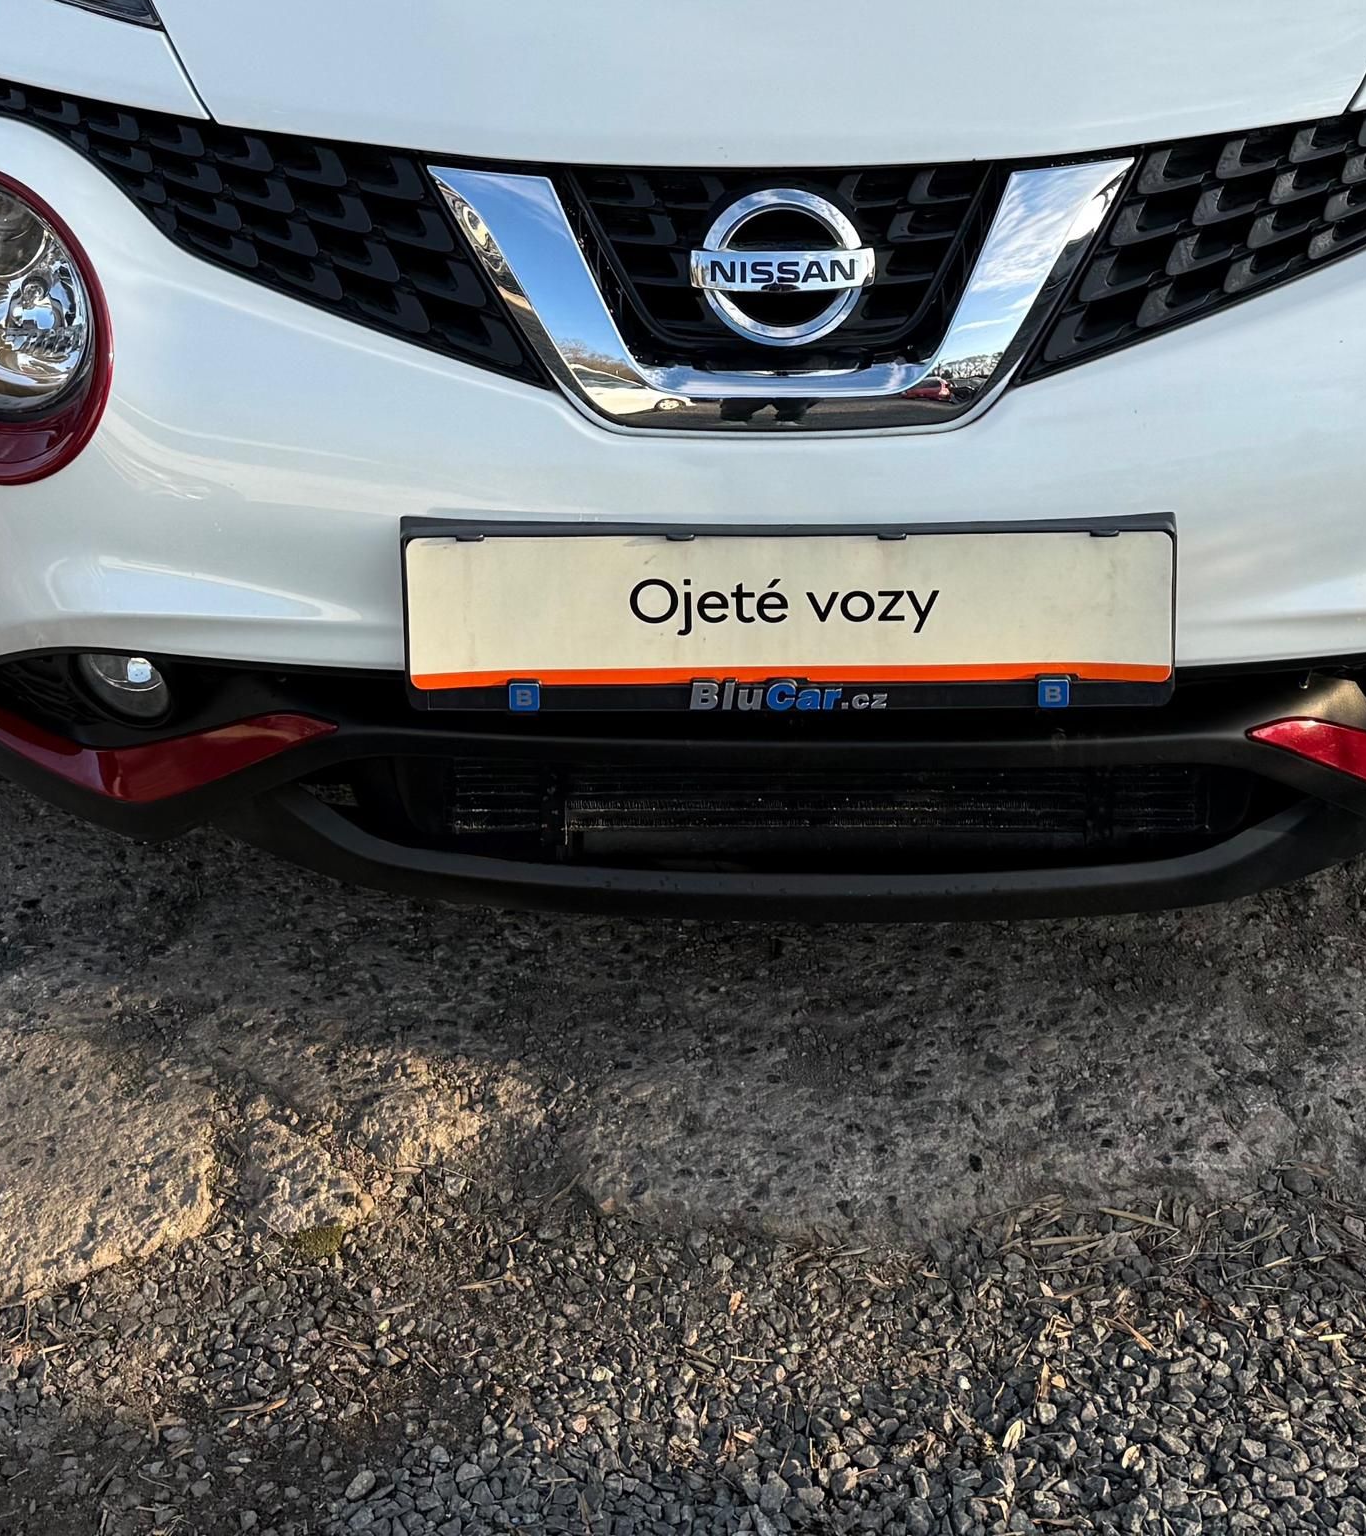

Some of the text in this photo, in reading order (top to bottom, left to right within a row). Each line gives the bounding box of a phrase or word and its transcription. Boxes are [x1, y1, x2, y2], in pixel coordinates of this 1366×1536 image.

[710, 258, 855, 283] NISSAN
[629, 578, 939, 636] Ojeté vozy
[516, 689, 532, 706] B
[689, 681, 888, 710] BluCar.cz
[1045, 685, 1061, 702] B
